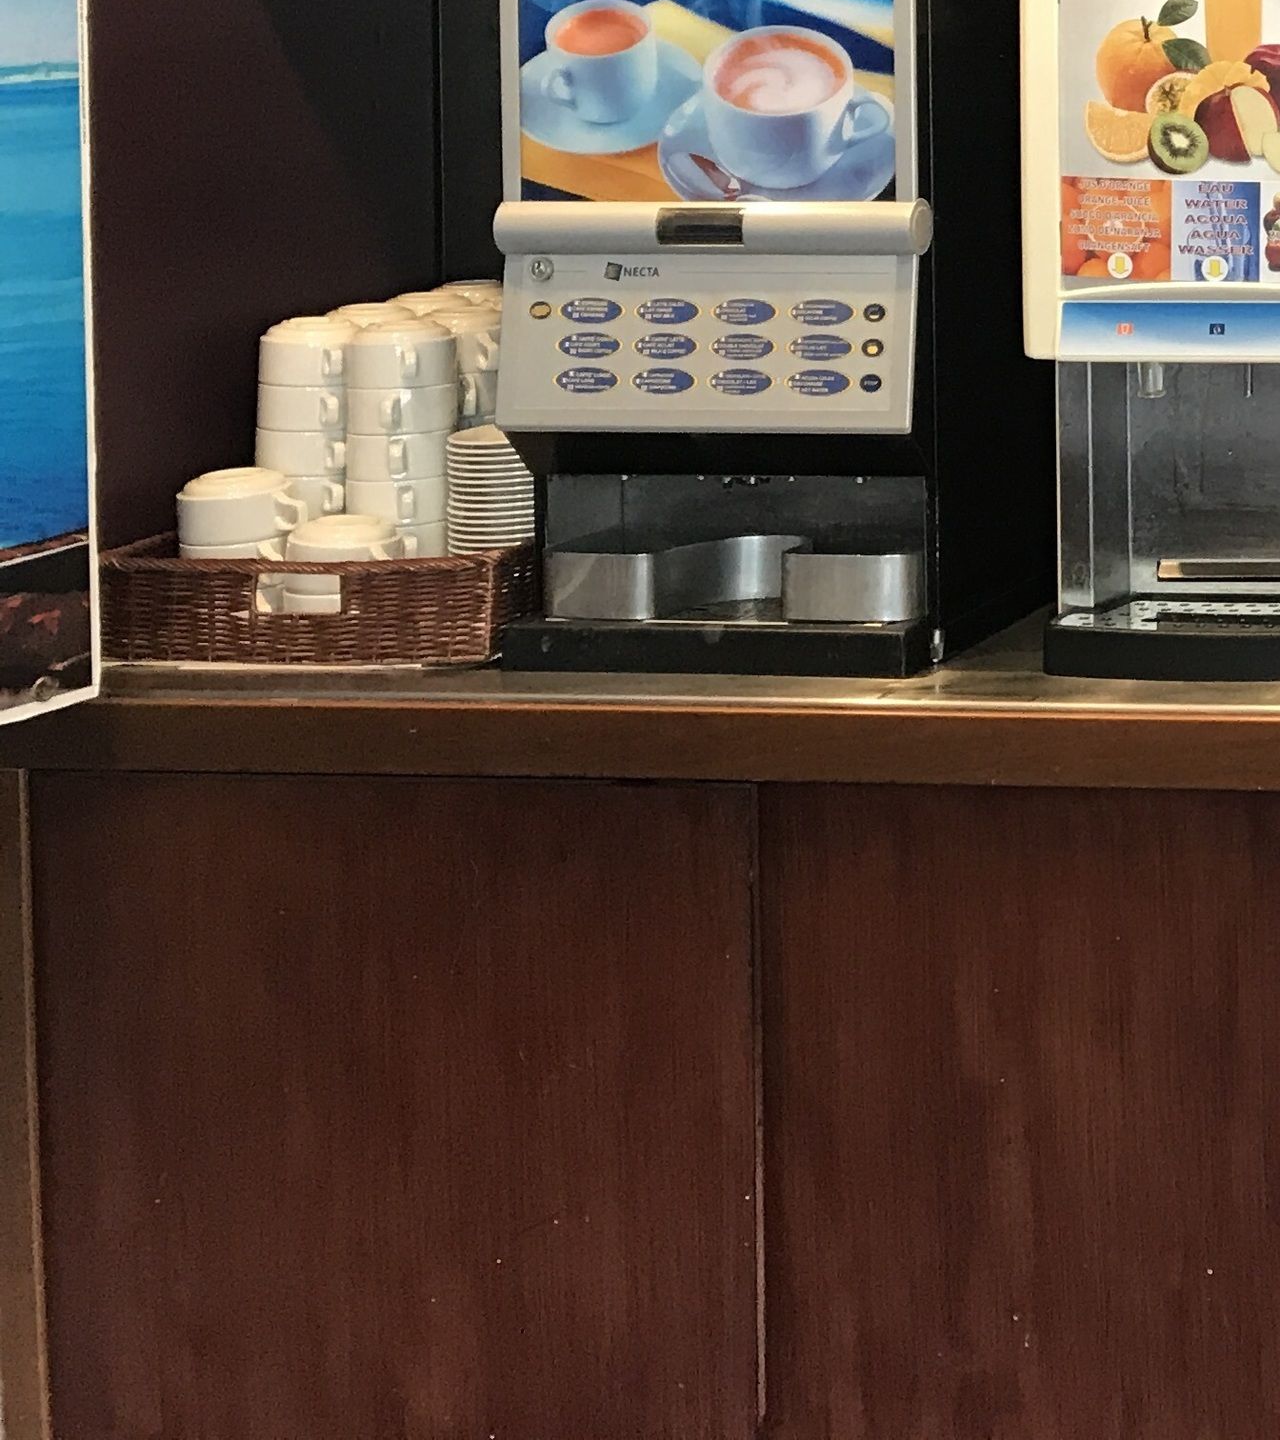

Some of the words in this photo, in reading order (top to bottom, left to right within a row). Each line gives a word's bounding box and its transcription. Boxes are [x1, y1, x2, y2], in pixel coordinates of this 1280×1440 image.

[1198, 183, 1234, 193] EAU
[1122, 196, 1151, 206] JUICE
[1184, 198, 1248, 209] WATER
[1184, 214, 1248, 224] ACQUA
[1190, 229, 1241, 239] AGUA
[1178, 244, 1254, 255] WASSER
[623, 266, 660, 277] NECTA
